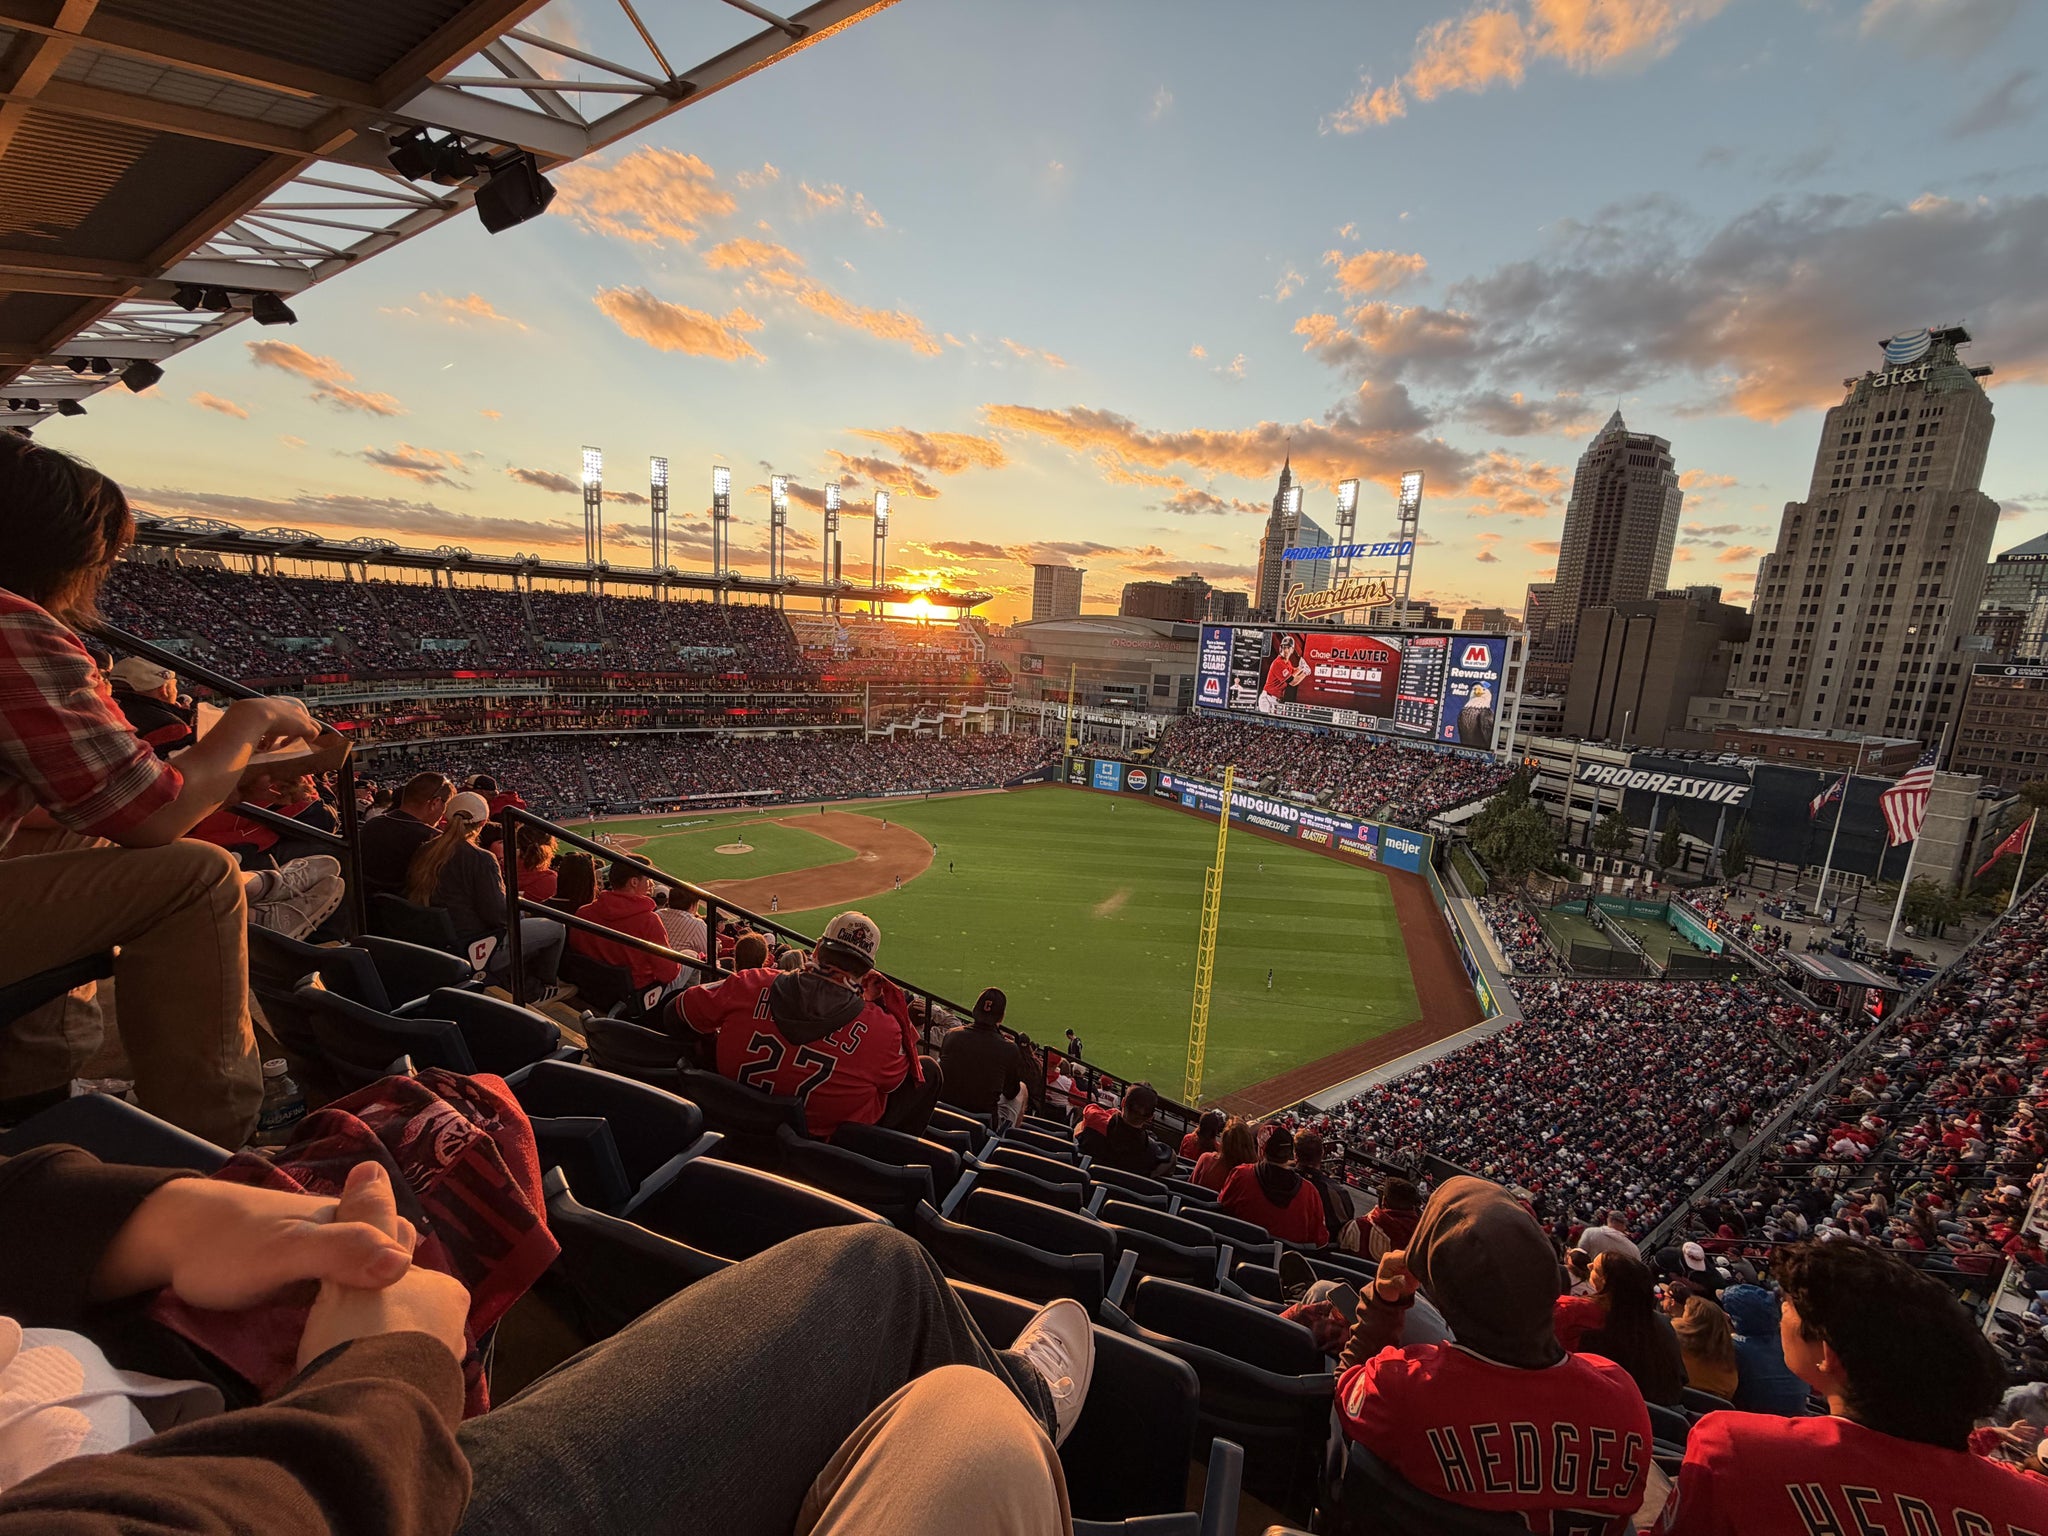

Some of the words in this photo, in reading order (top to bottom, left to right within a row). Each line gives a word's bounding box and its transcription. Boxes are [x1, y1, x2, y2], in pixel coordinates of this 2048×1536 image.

[1872, 363, 1932, 388] at&t
[1281, 543, 1368, 560] PROGRESSIVE
[1369, 541, 1413, 557] FIELD
[1285, 579, 1388, 621] Guardians
[1203, 654, 1226, 663] STAND
[1309, 649, 1331, 659] Chase
[1202, 662, 1226, 671] GUARD
[1450, 667, 1498, 680] Rewards
[1087, 714, 1113, 724] BREWED
[1208, 710, 1233, 719] HONDA
[1286, 721, 1316, 732] HONDA
[1444, 725, 1454, 738] C
[1095, 773, 1118, 781] Cleveland
[1580, 764, 1750, 805] PROGRESSIVE
[1246, 814, 1292, 833] PROGRESSIVE
[1301, 829, 1328, 844] BLASTER
[1340, 838, 1372, 852] PHANTOM
[1385, 837, 1421, 855] meijer
[475, 942, 487, 960] C
[648, 992, 656, 1007] C
[737, 1030, 839, 1110] 27
[1425, 1420, 1643, 1499] HEDGES
